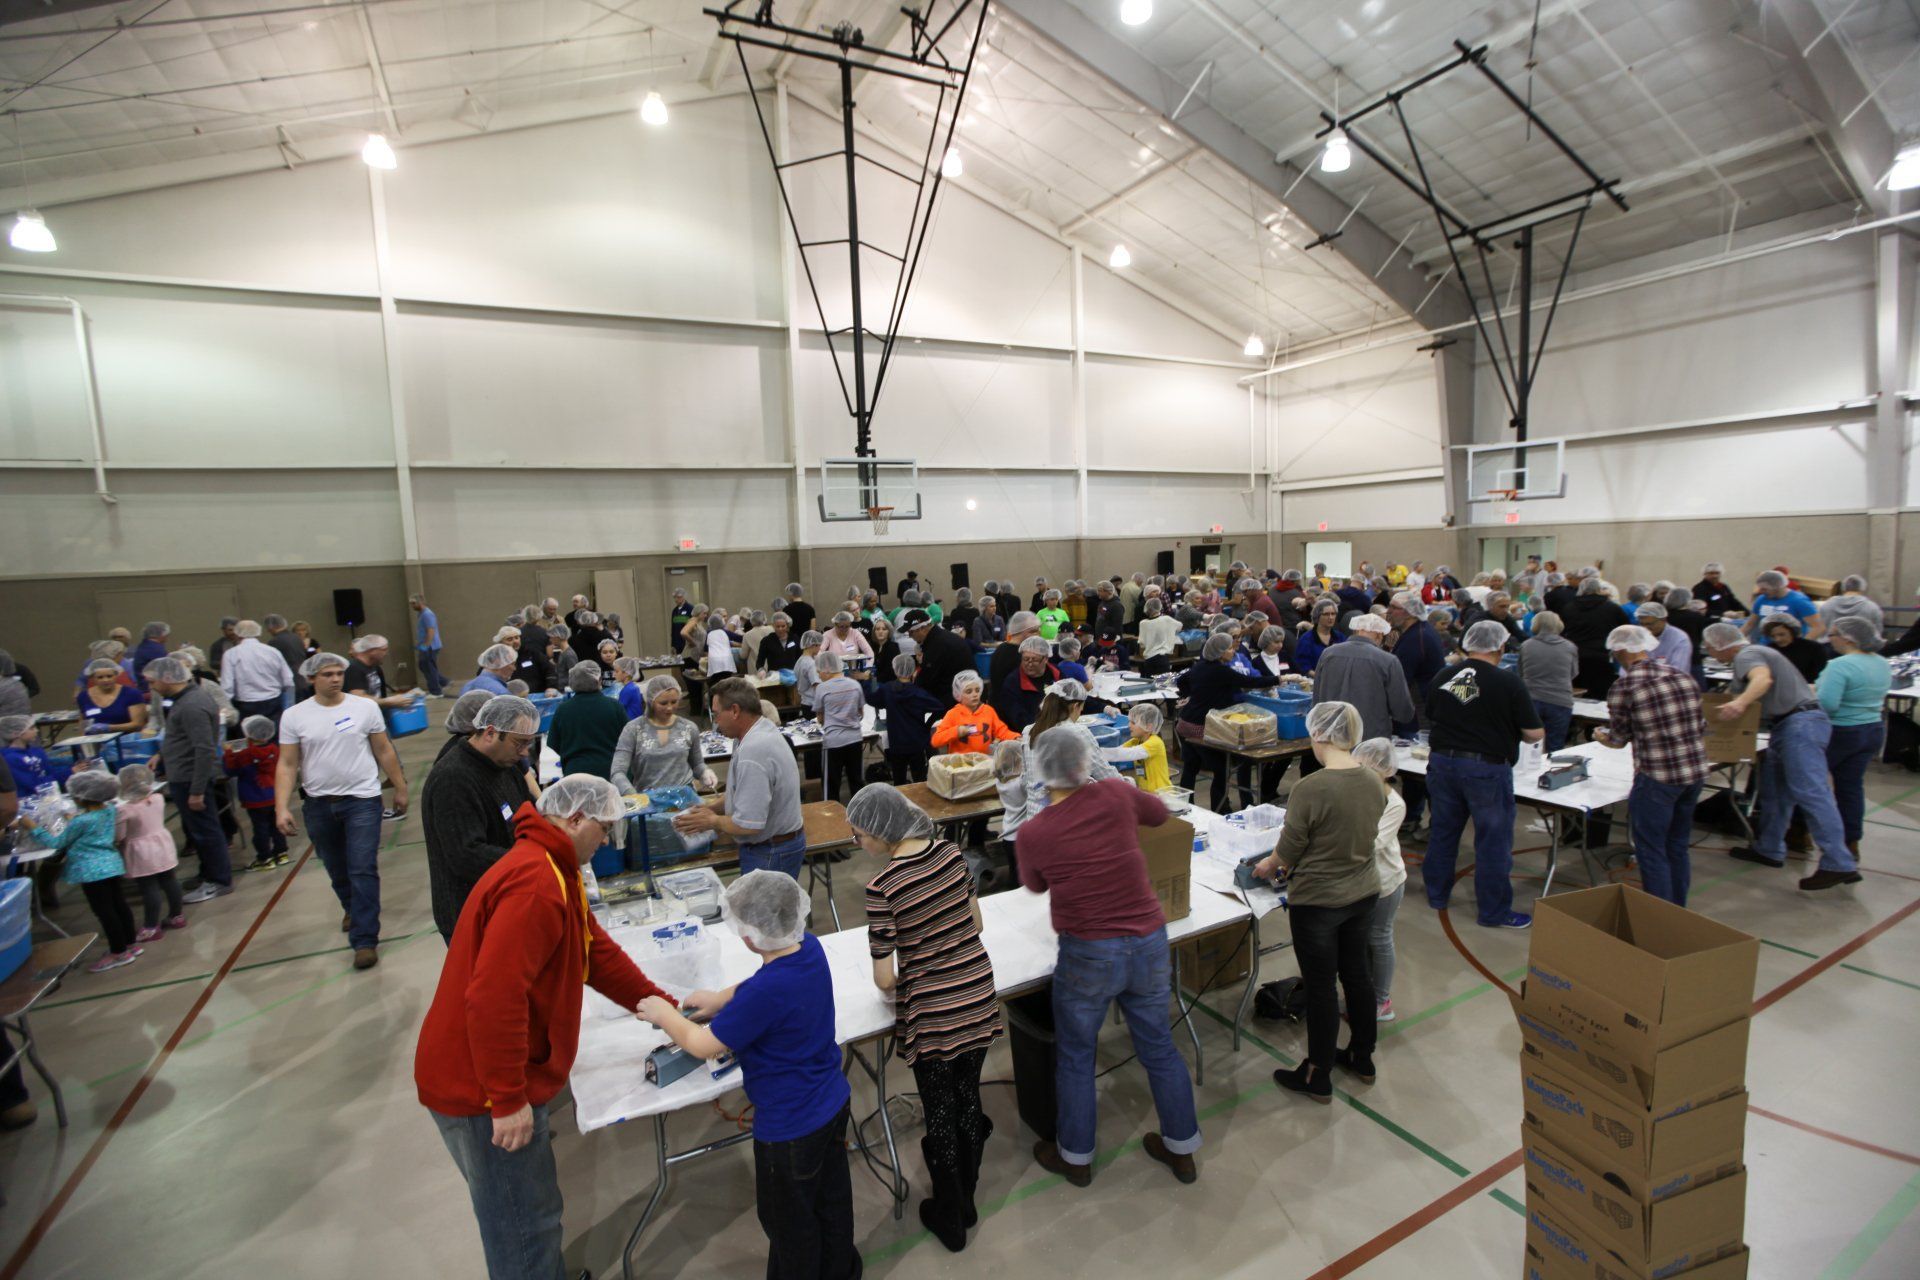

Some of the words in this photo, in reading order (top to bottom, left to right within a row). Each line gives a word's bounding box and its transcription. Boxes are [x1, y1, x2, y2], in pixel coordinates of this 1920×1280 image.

[1526, 1077, 1585, 1117] MannaPack
[1527, 1148, 1585, 1195] MannaPack
[1531, 1212, 1588, 1264] MannaPack
